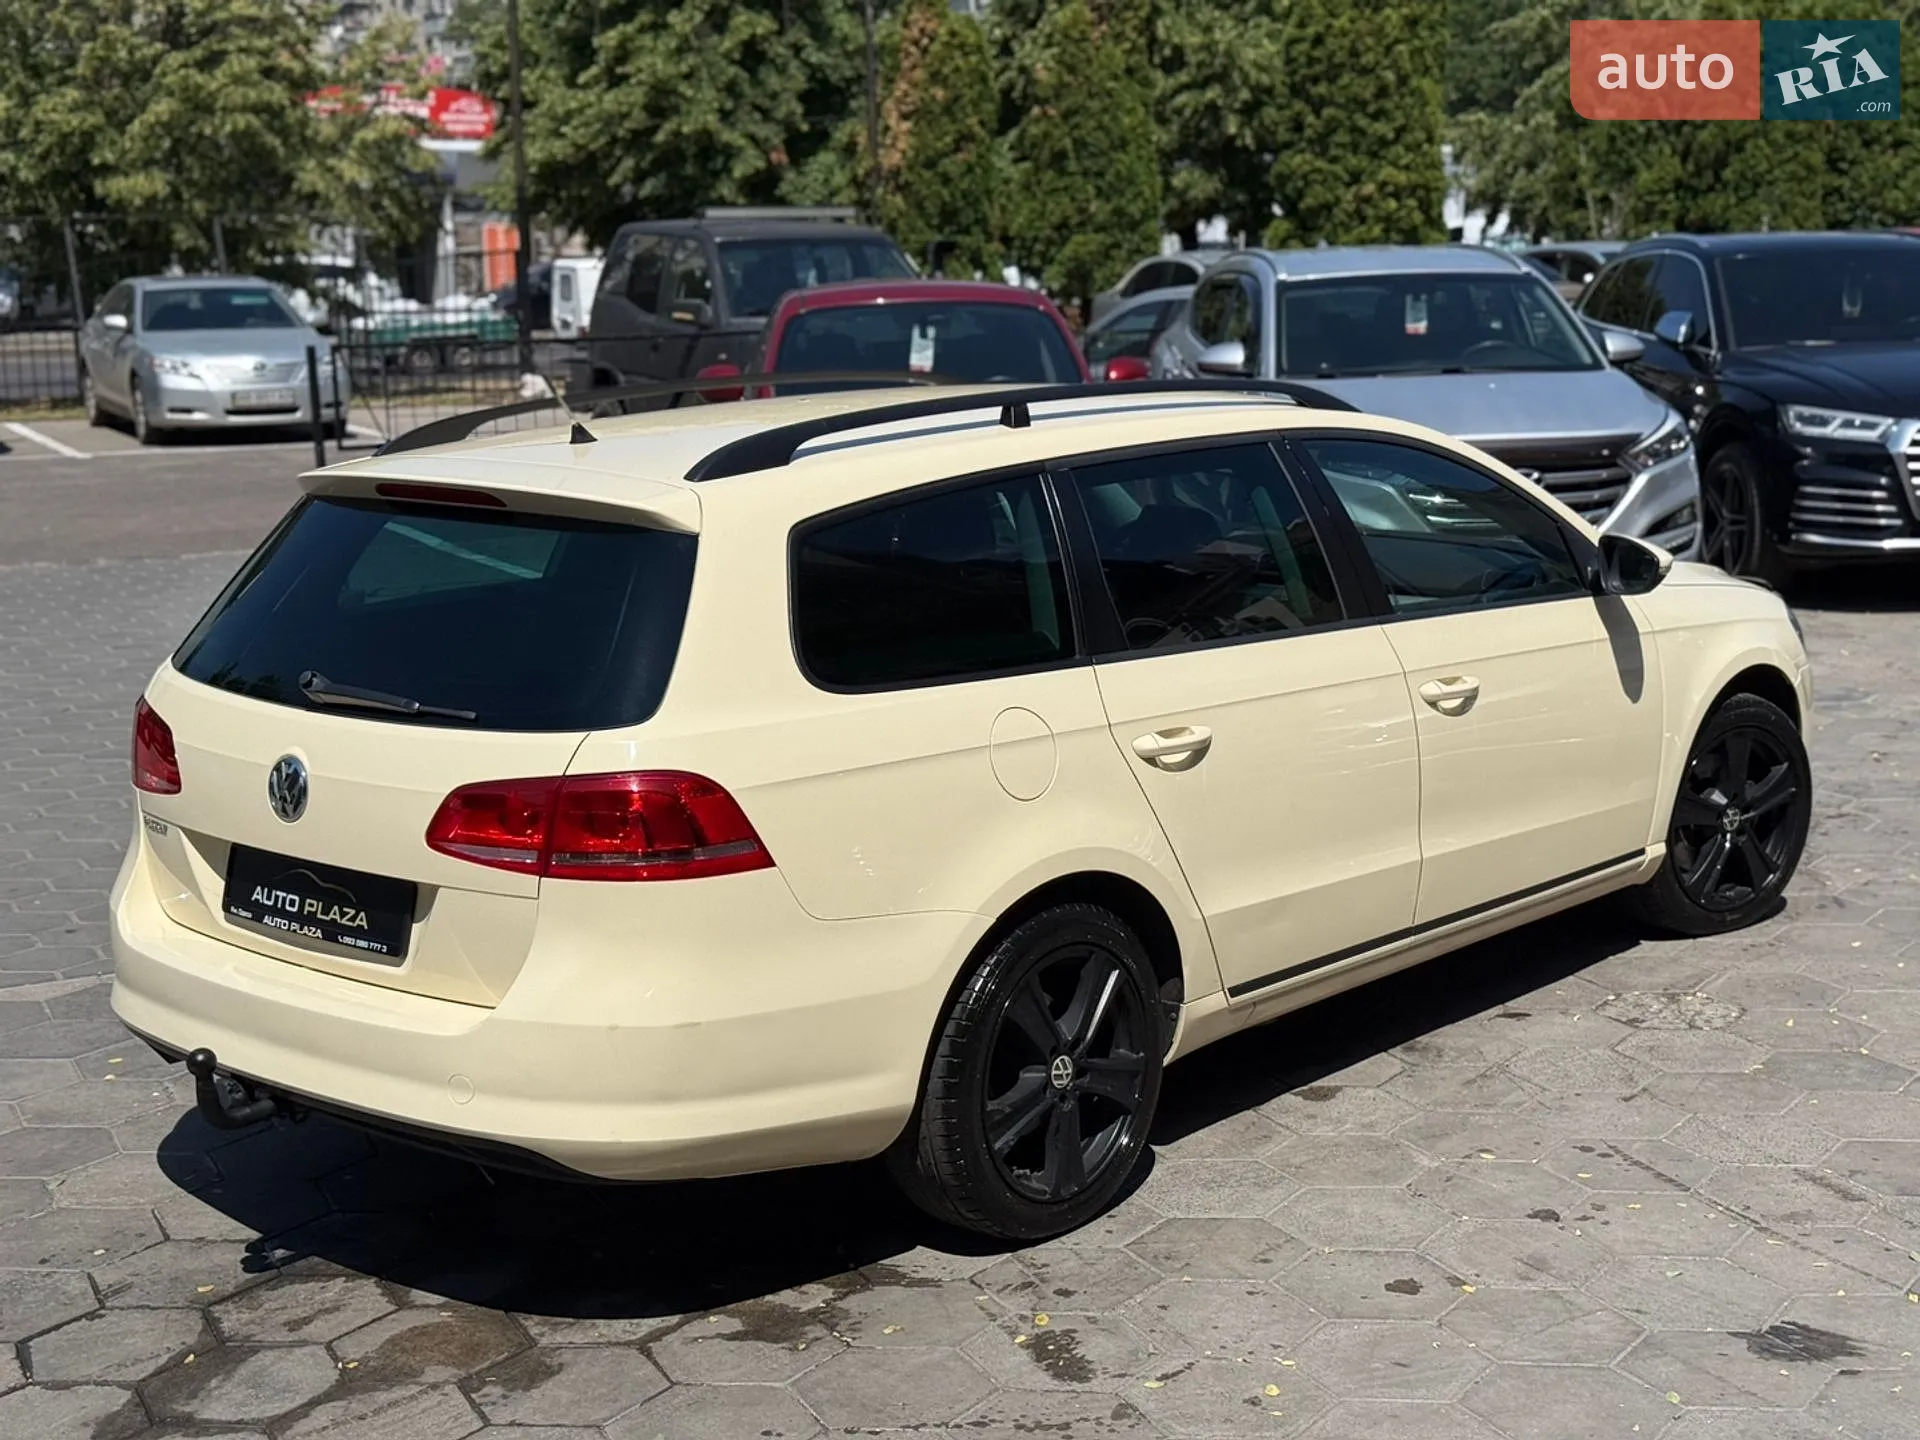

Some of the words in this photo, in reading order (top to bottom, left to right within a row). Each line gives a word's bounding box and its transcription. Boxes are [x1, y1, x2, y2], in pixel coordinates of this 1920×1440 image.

[251, 885, 300, 912] AUTO
[303, 898, 368, 930] PLAZA
[263, 914, 289, 930] AUTO
[290, 921, 323, 939] PLAZA
